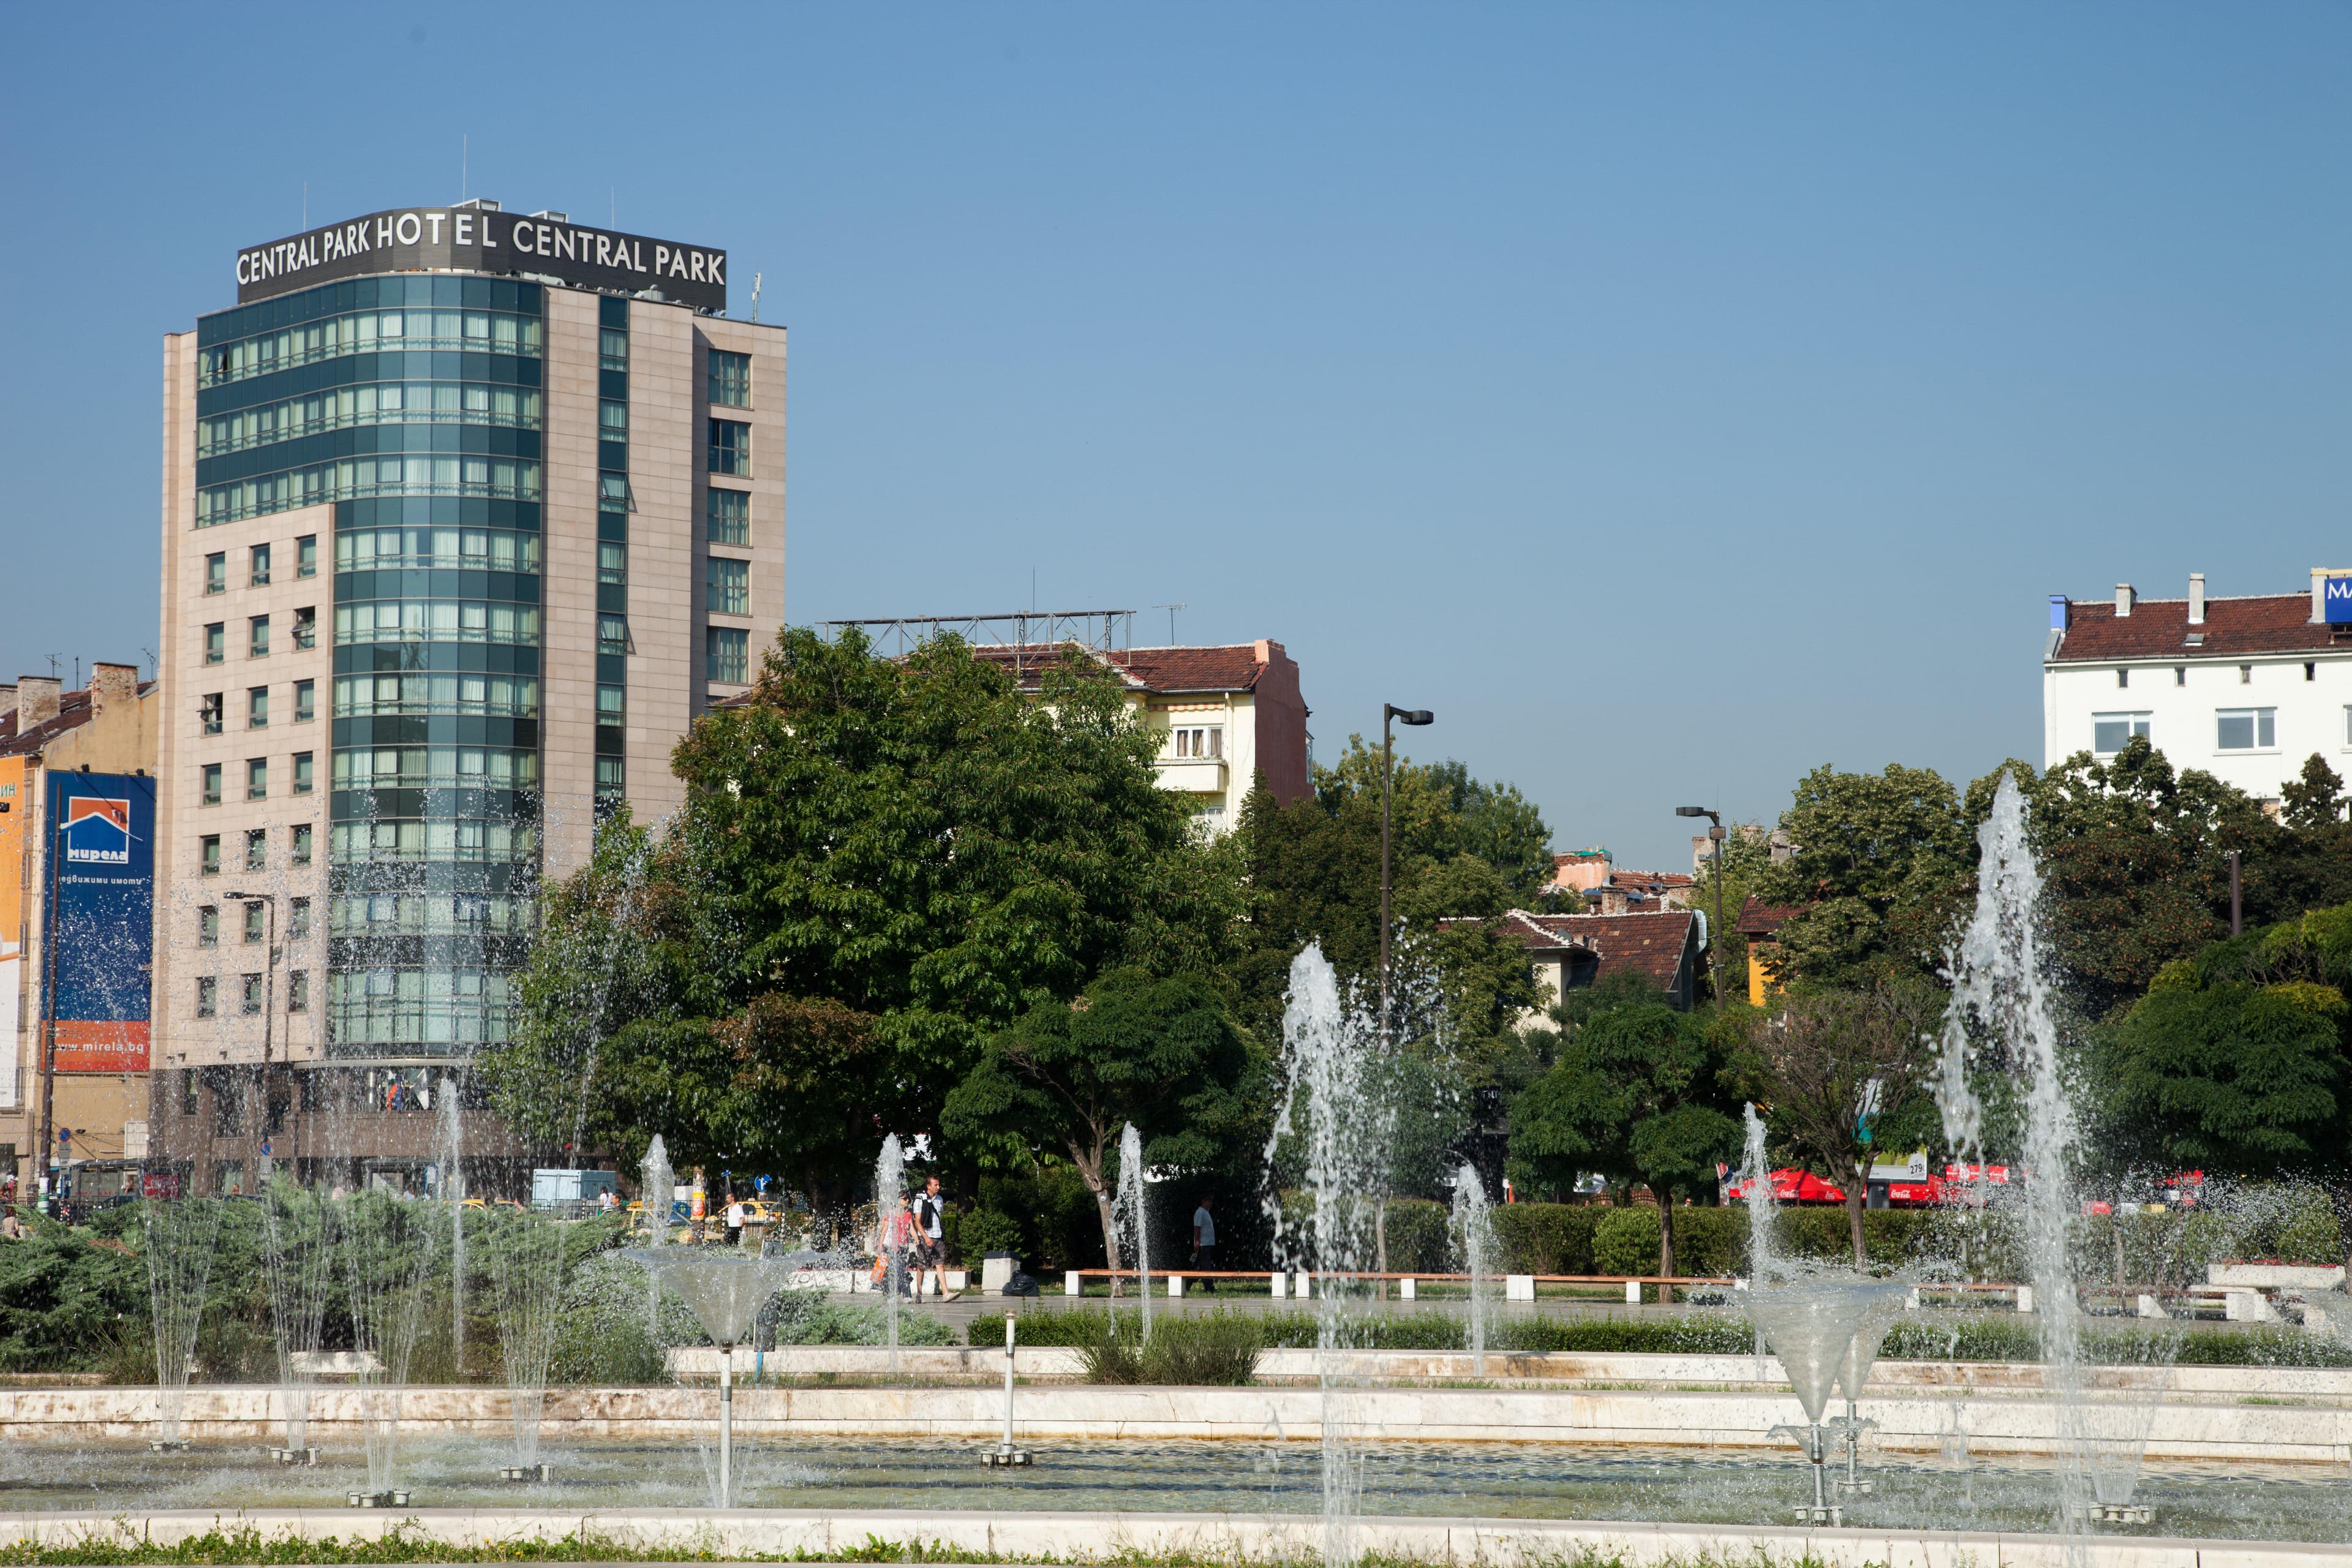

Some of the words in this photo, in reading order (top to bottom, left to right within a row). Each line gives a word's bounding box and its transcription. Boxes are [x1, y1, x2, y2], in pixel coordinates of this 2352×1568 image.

[377, 213, 497, 249] HOTEL
[236, 236, 319, 285] CENTRAL
[324, 221, 371, 262] PARK
[513, 221, 647, 273] CENTRAL
[655, 244, 725, 285] PARK
[2328, 581, 2352, 600] M
[69, 849, 128, 862] мирела
[56, 1041, 144, 1054] ww.mirela.bg
